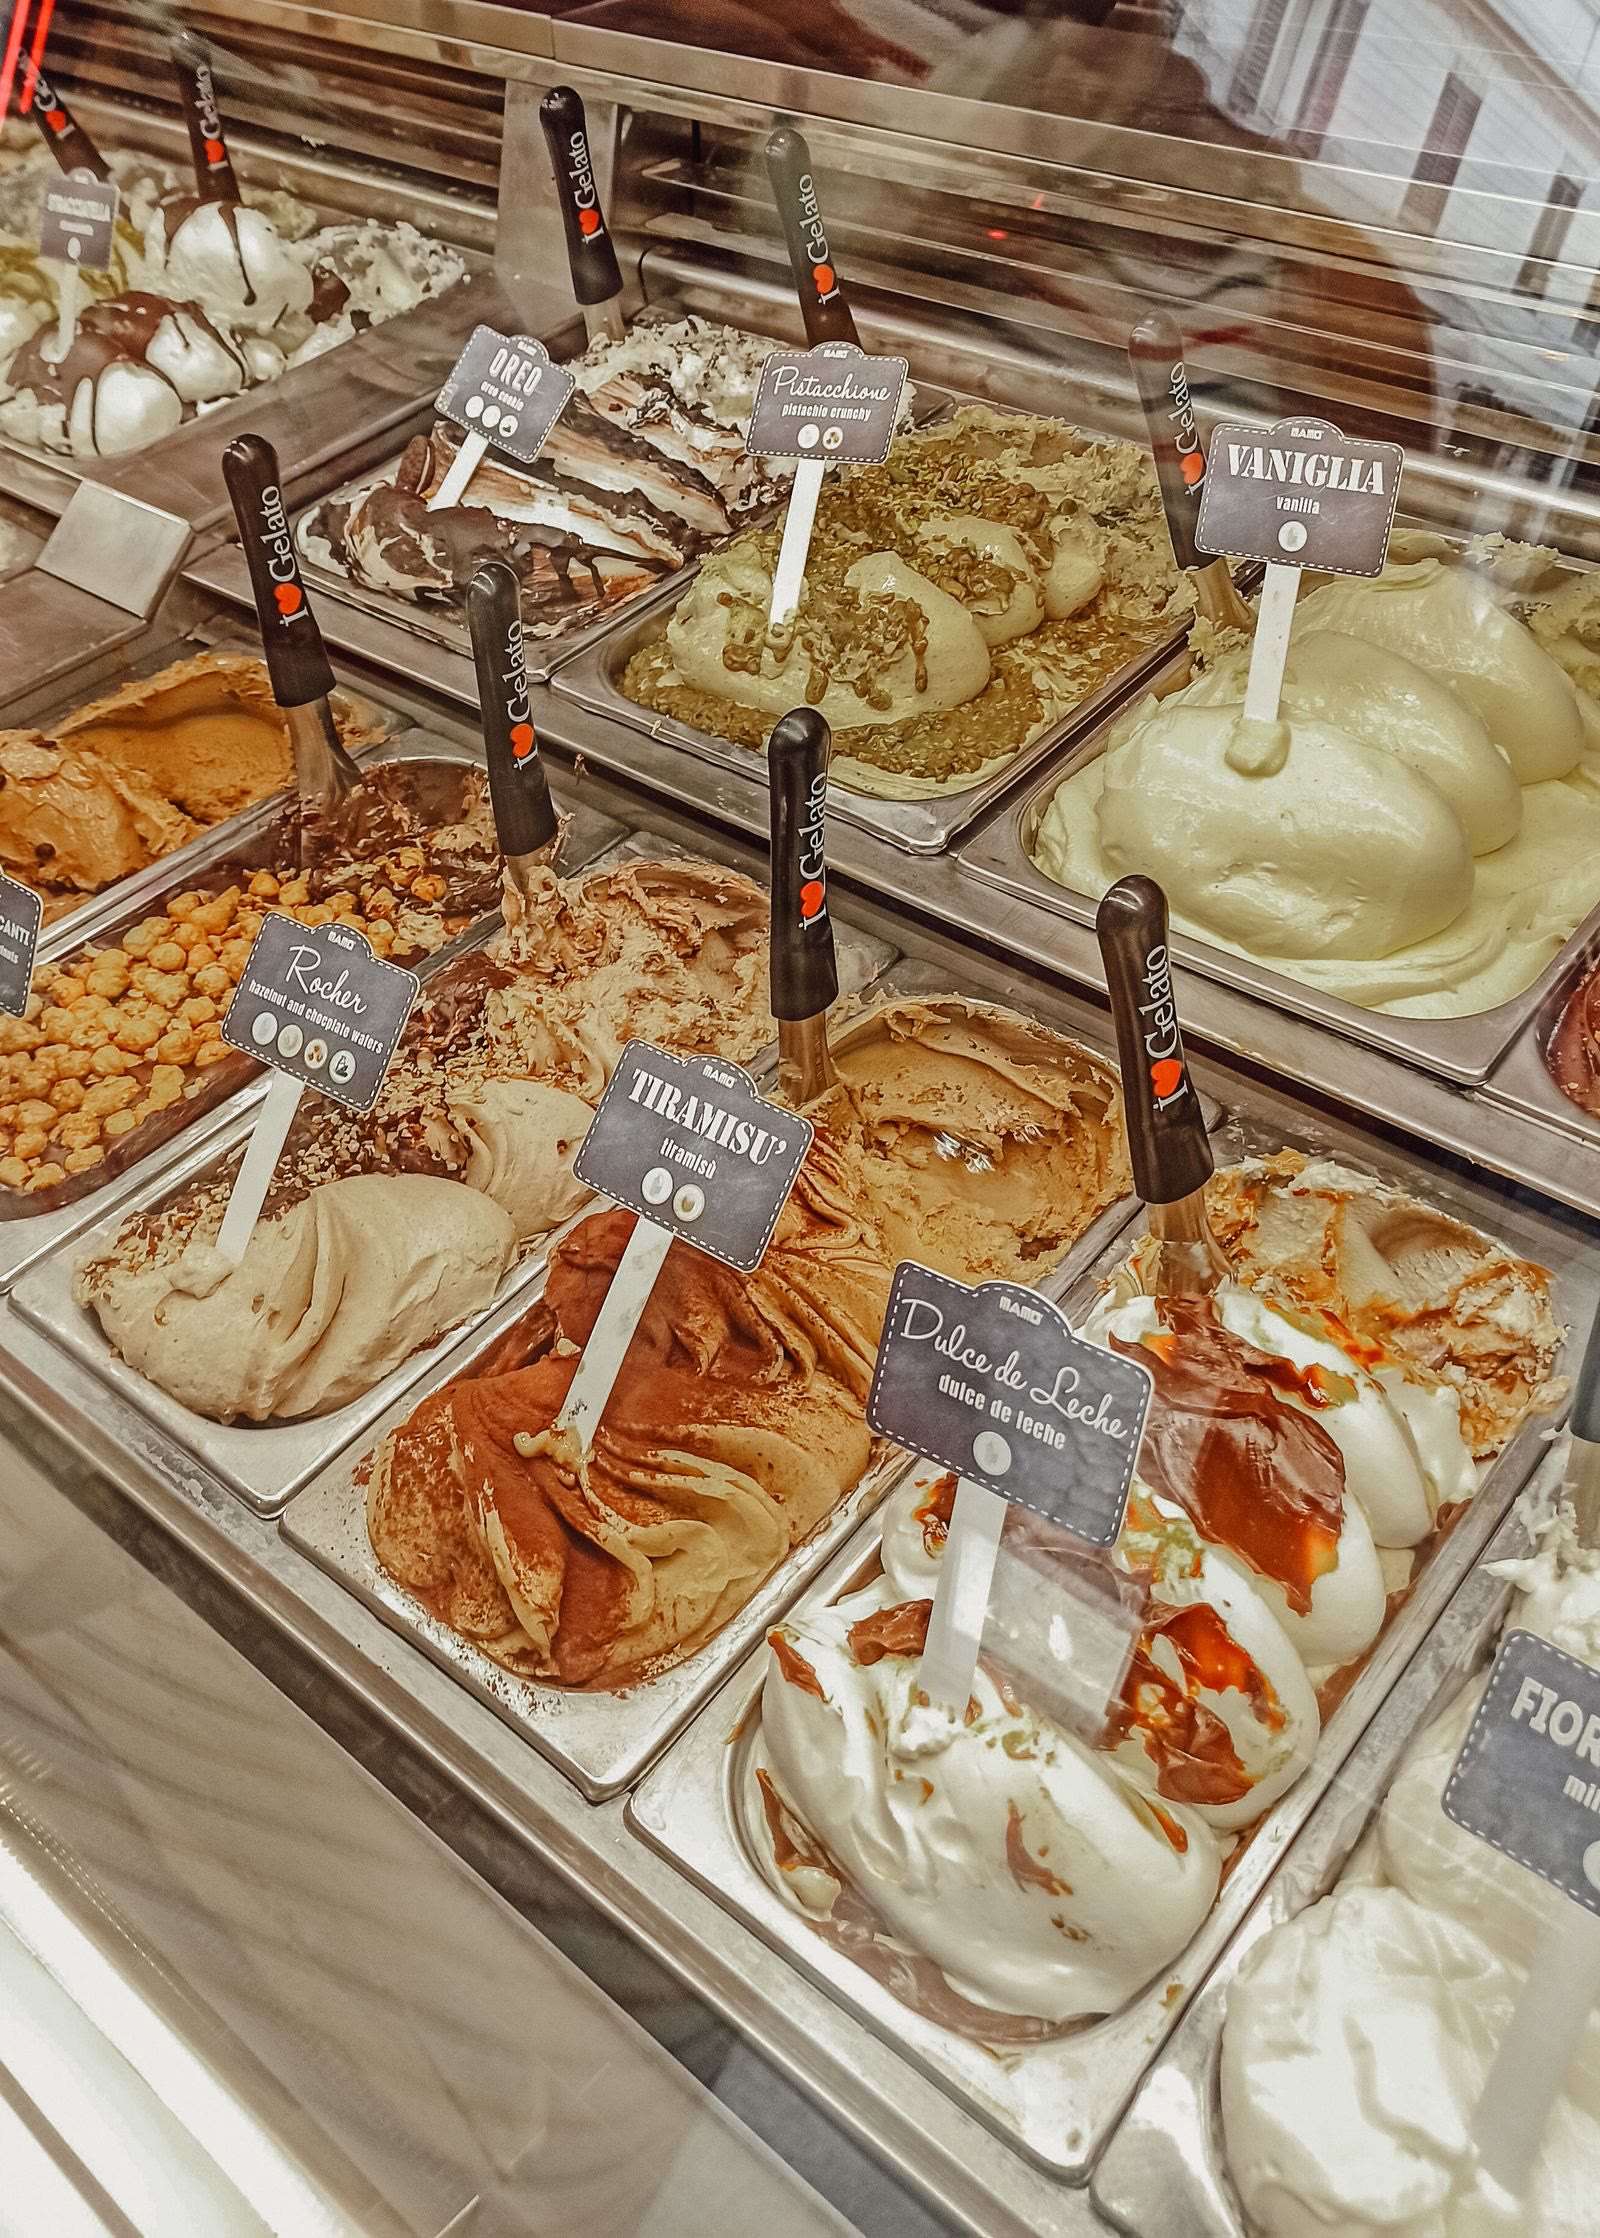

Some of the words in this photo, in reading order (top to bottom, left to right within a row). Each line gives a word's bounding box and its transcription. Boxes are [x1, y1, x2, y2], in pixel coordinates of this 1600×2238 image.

[569, 131, 596, 209] Gelato
[799, 174, 829, 264] Gelato
[488, 348, 543, 396] OREO
[771, 365, 892, 401] Pistacchione
[1168, 361, 1198, 454] Gelato
[782, 402, 828, 418] pistachio
[830, 406, 872, 422] crunchy
[1228, 443, 1385, 495] VANIGLIA
[1275, 496, 1321, 515] vanilla
[260, 485, 297, 583] Gelato
[502, 619, 530, 723] Gelato
[798, 771, 828, 881] Gelato
[248, 979, 288, 1007] hazelnut
[286, 998, 306, 1017] and
[350, 1029, 385, 1055] wafers
[285, 944, 368, 1015] Rocher
[1138, 945, 1178, 1059] Gelato
[658, 1137, 717, 1180] tiramisù
[900, 1298, 993, 1374] Dulce
[994, 1351, 1028, 1391] de
[1029, 1366, 1128, 1439] Leche
[938, 1374, 986, 1411] dulce
[989, 1399, 1011, 1424] de
[1015, 1410, 1067, 1450] leche
